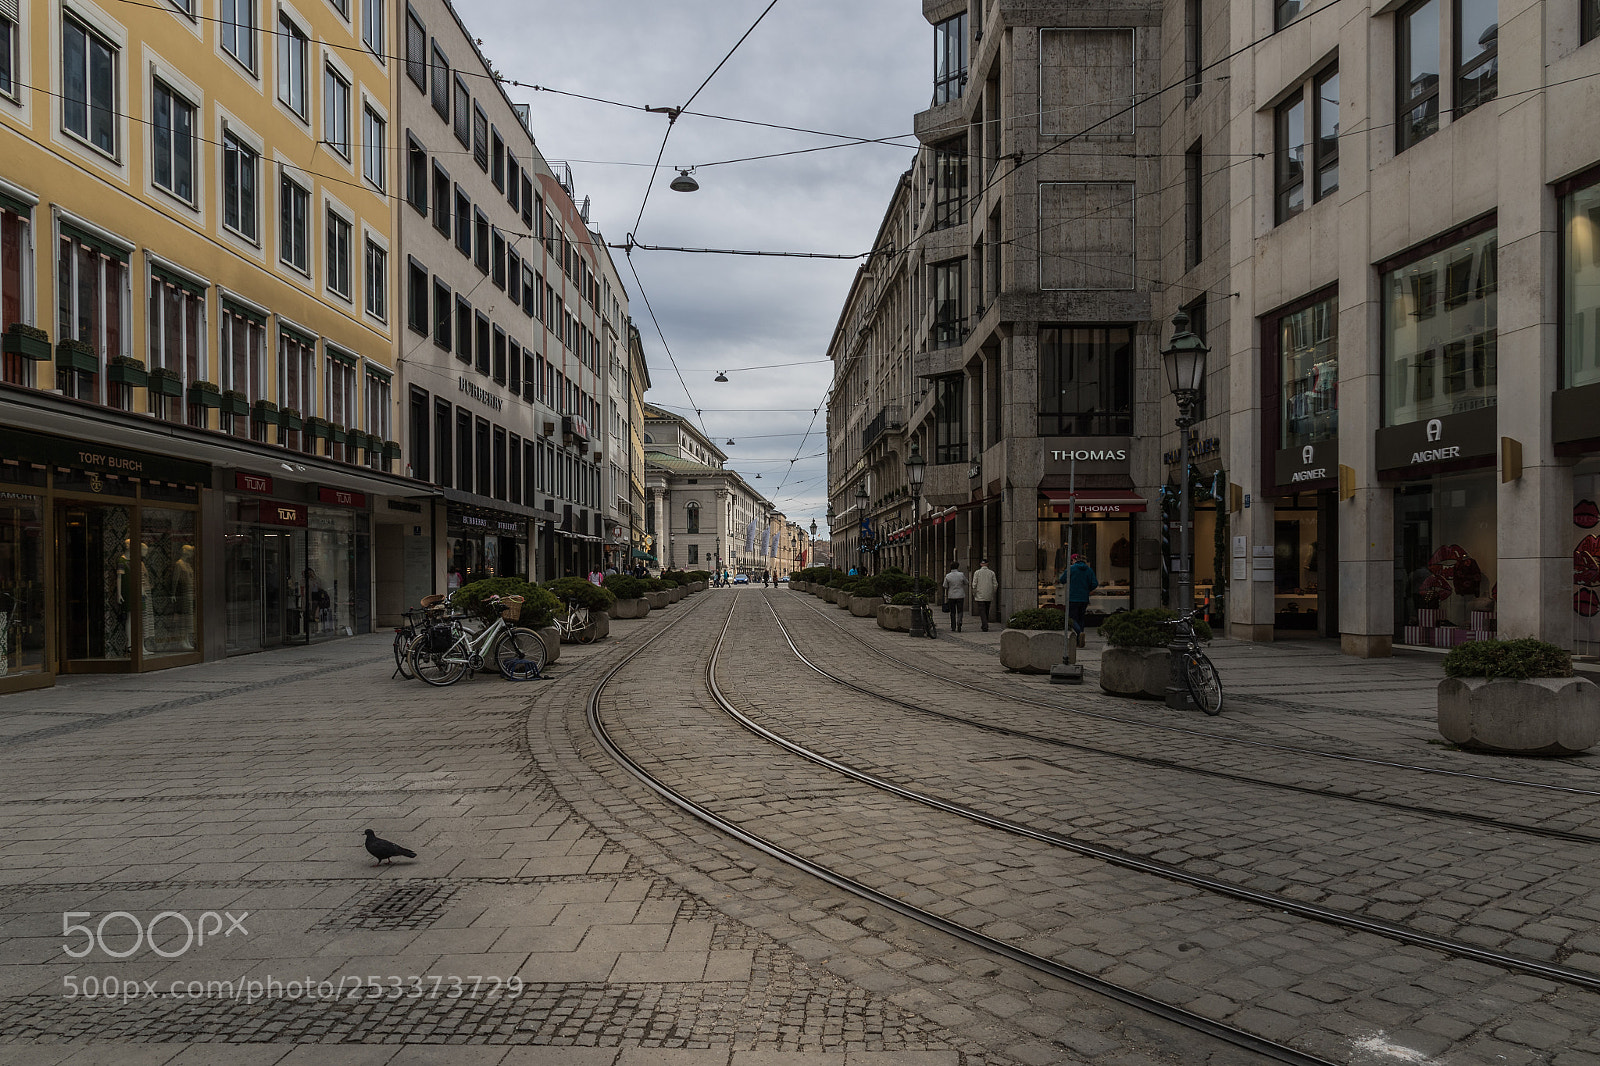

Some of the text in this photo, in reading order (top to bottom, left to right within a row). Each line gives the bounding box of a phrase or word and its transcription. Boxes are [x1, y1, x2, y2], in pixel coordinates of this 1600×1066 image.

[459, 376, 503, 412] BURBERRY
[78, 451, 143, 471] TORY BURCH
[1050, 449, 1126, 461] THOMAS
[1410, 445, 1460, 464] AIGNER
[1291, 468, 1326, 483] AIGNER
[244, 476, 266, 492] TUMI
[335, 492, 352, 505] TUMI
[277, 508, 296, 521] TUMI
